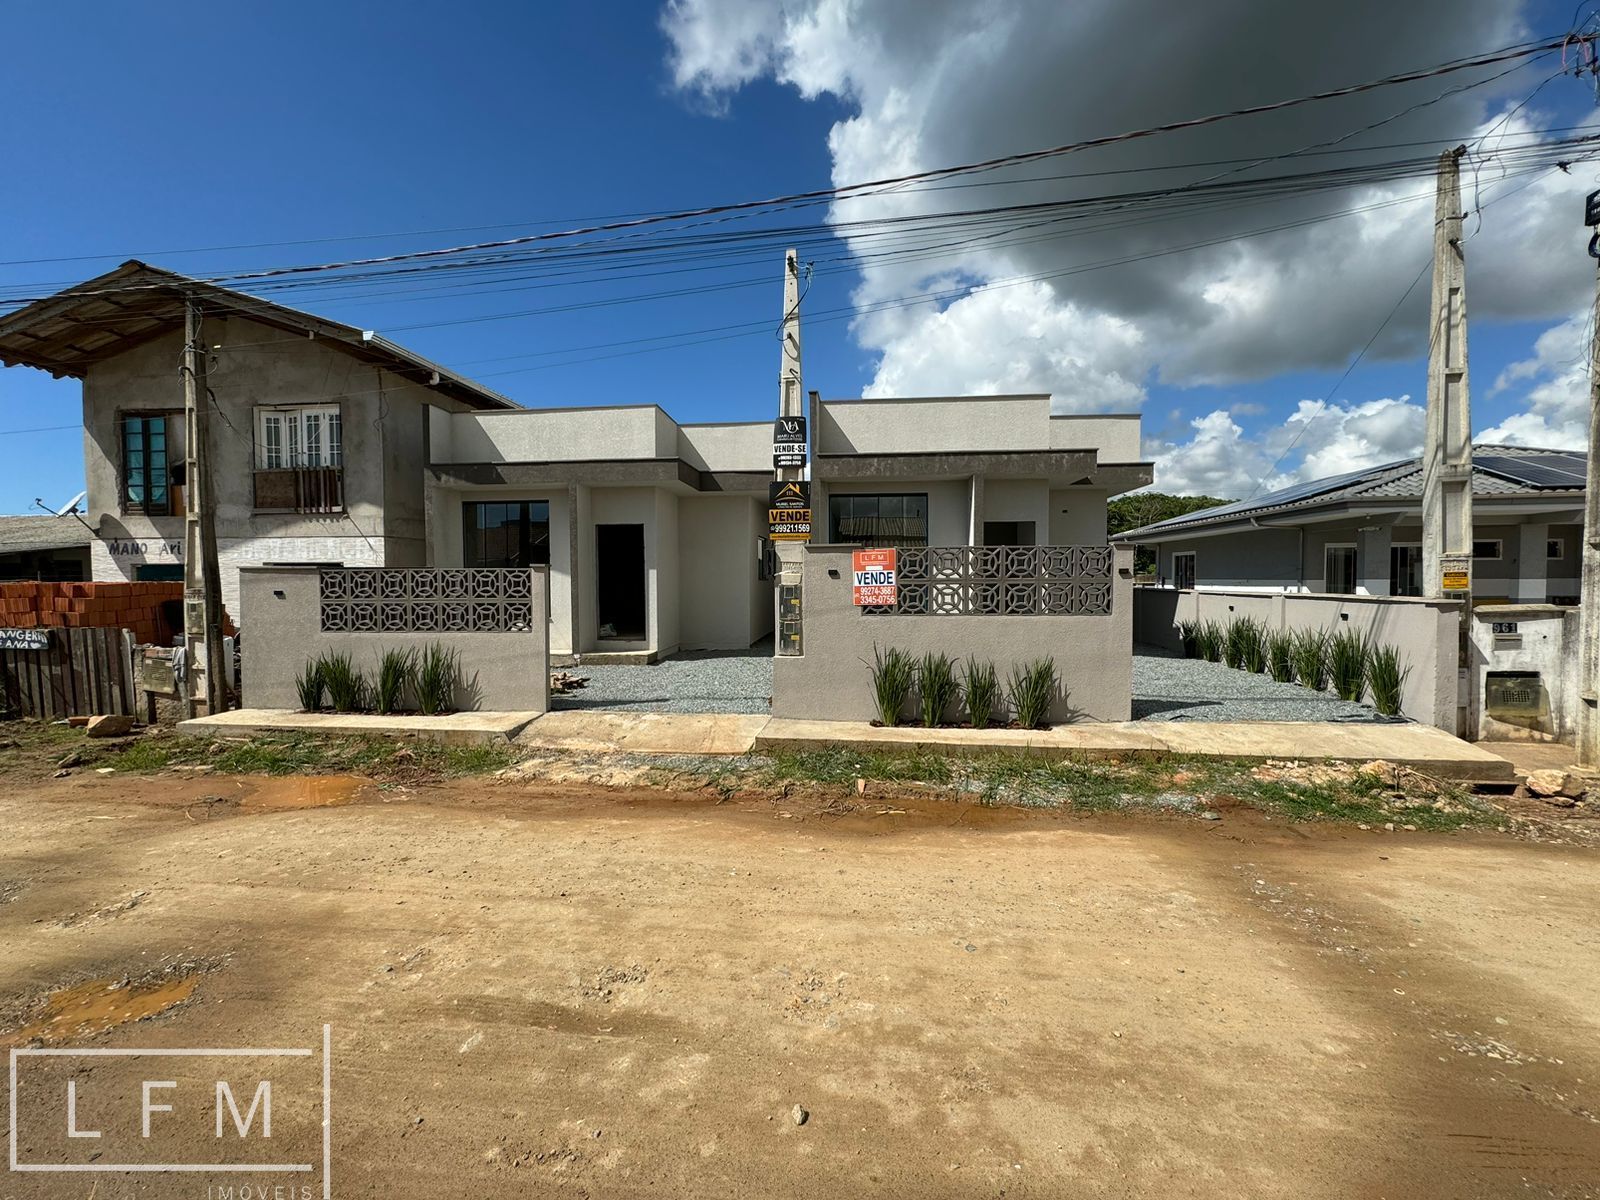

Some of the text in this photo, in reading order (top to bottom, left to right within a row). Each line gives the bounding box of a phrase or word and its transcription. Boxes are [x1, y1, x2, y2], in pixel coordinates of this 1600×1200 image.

[774, 444, 807, 453] VENDE-SE
[770, 511, 810, 522] VENDE
[109, 542, 148, 555] MANO
[856, 571, 894, 585] VENDE
[860, 595, 895, 604] 3345-0756
[1493, 623, 1518, 633] 961
[6, 639, 29, 649] ANA
